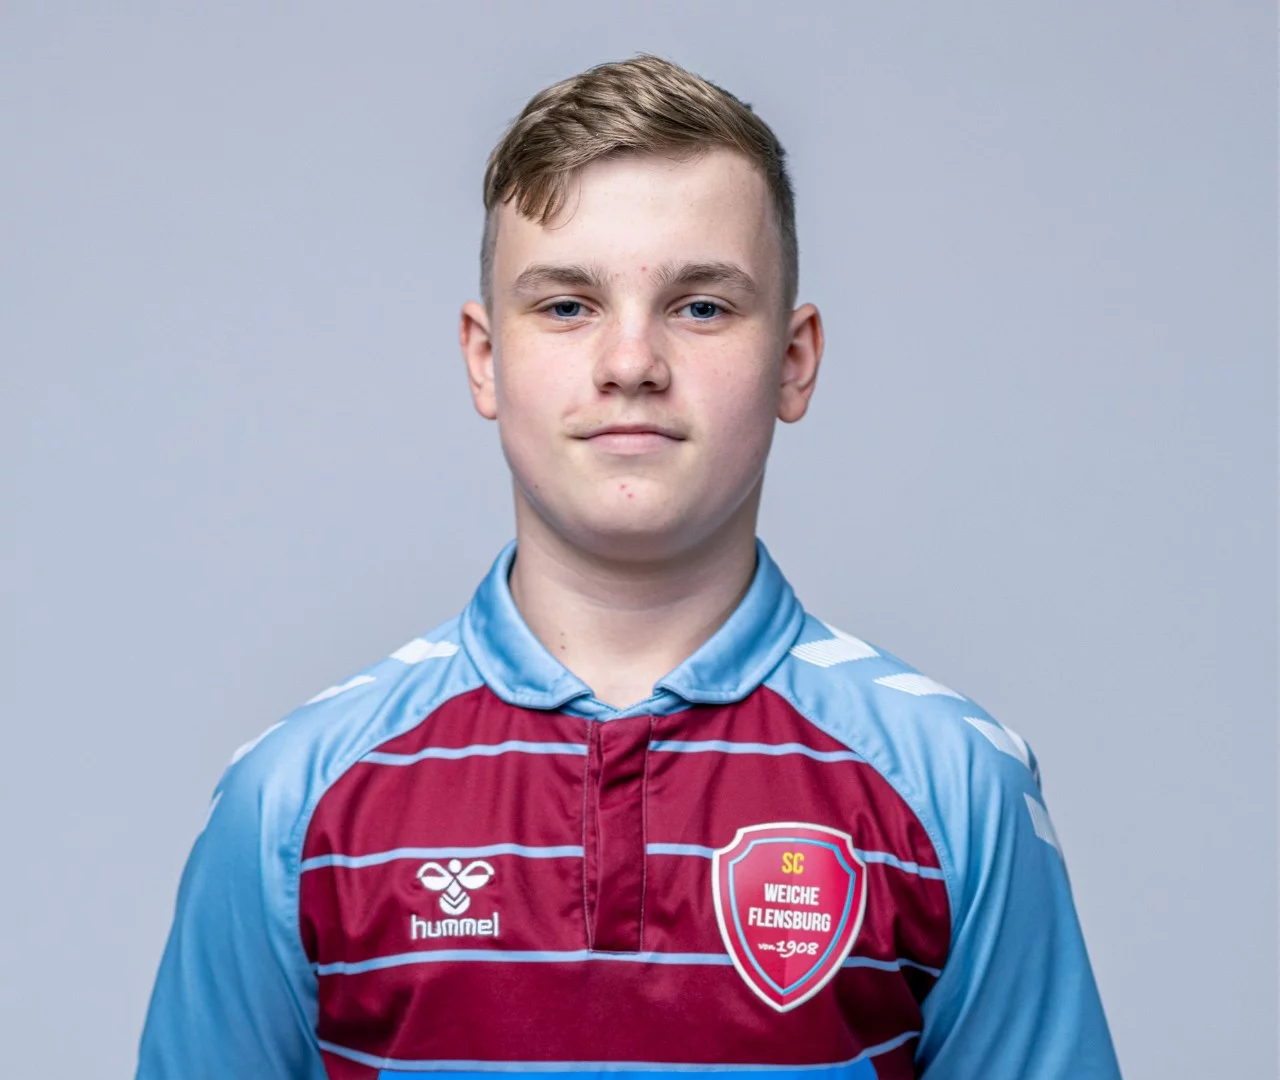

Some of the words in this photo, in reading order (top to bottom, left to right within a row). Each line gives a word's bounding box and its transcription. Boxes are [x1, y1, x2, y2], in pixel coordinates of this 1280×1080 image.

[782, 852, 804, 874] SC
[764, 883, 820, 905] WEICHE
[411, 912, 501, 940] hummel
[748, 907, 831, 932] FLENSBURG
[776, 940, 819, 958] 1908
